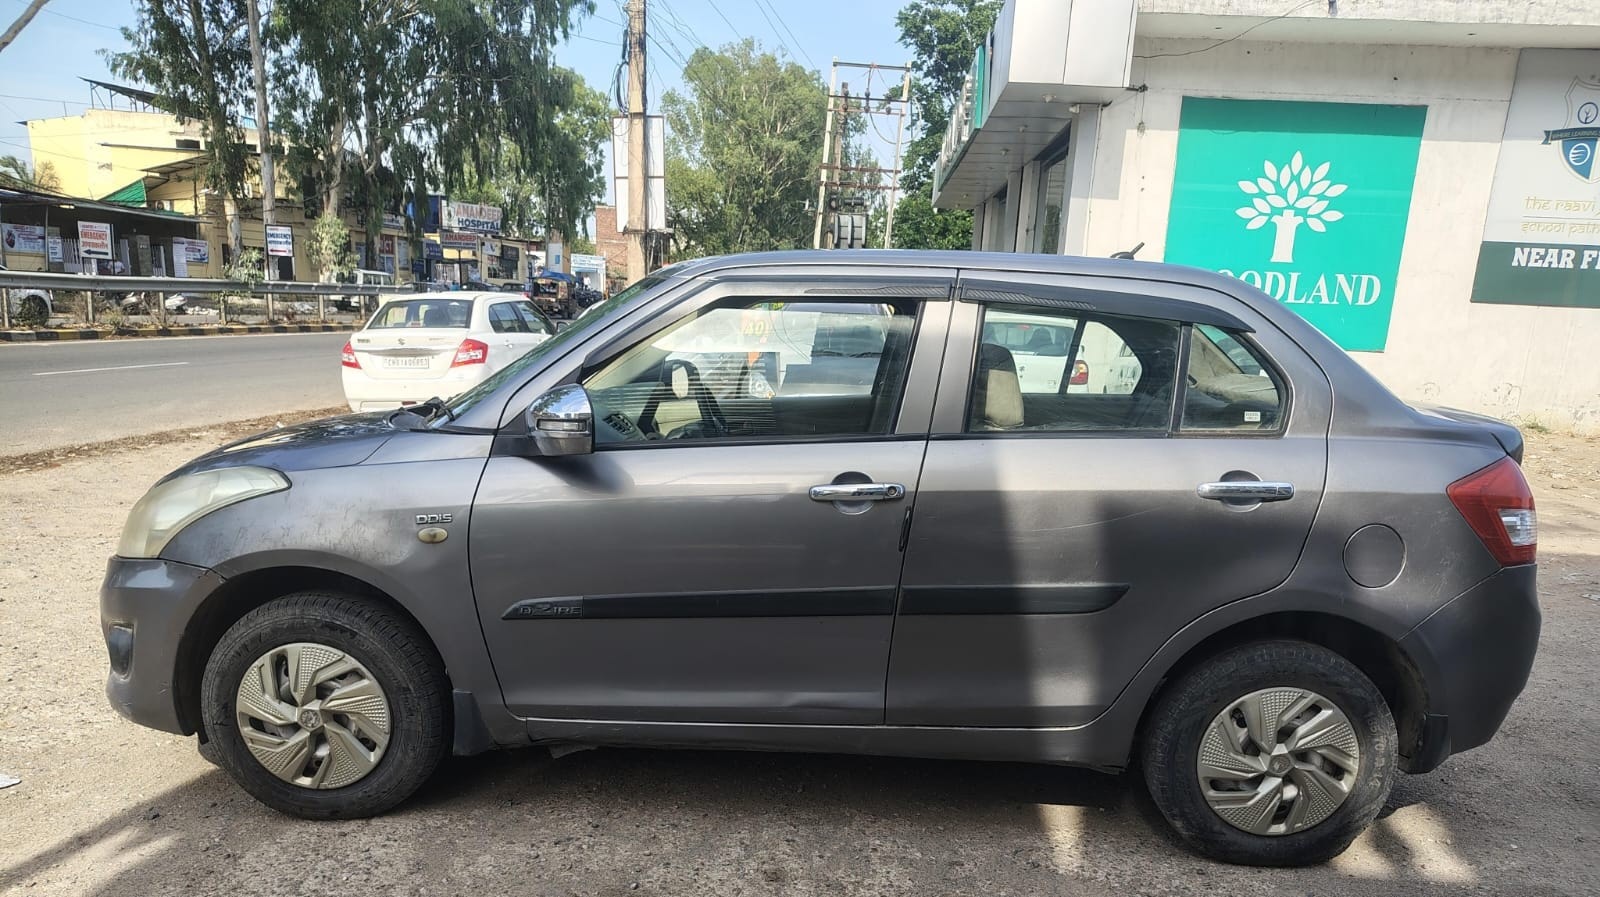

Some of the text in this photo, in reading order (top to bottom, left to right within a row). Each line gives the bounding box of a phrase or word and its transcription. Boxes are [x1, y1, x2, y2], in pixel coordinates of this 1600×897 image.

[457, 217, 499, 231] HOSPITAL
[80, 231, 108, 241] EMERGENCY
[1511, 247, 1575, 268] NEAR
